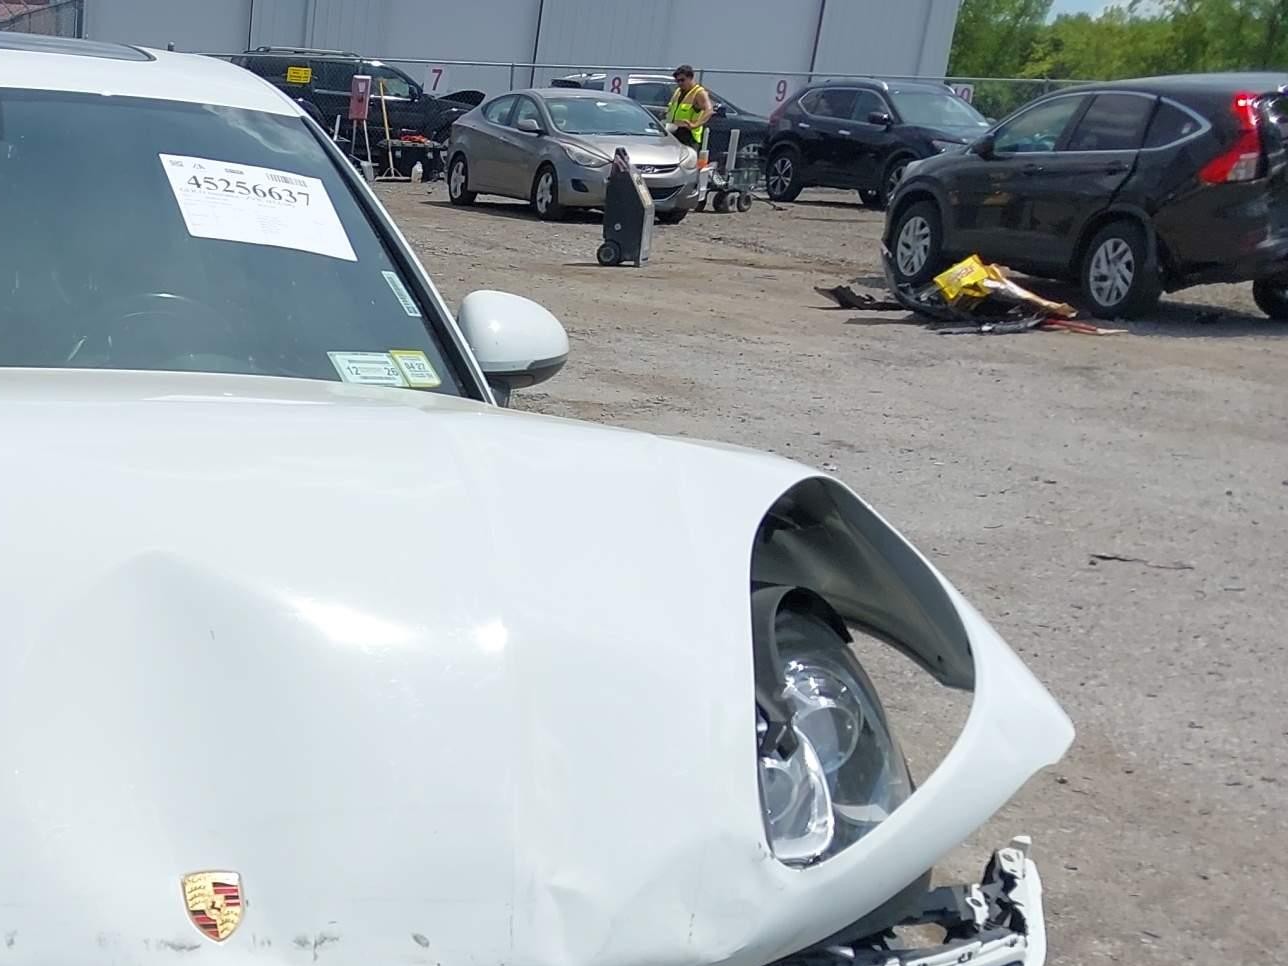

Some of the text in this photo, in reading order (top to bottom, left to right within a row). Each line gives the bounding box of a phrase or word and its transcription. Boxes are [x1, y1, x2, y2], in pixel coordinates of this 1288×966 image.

[432, 69, 442, 90] 7
[611, 76, 622, 94] 8
[775, 79, 787, 102] 9
[187, 175, 310, 206] 45256637
[347, 366, 361, 376] 12
